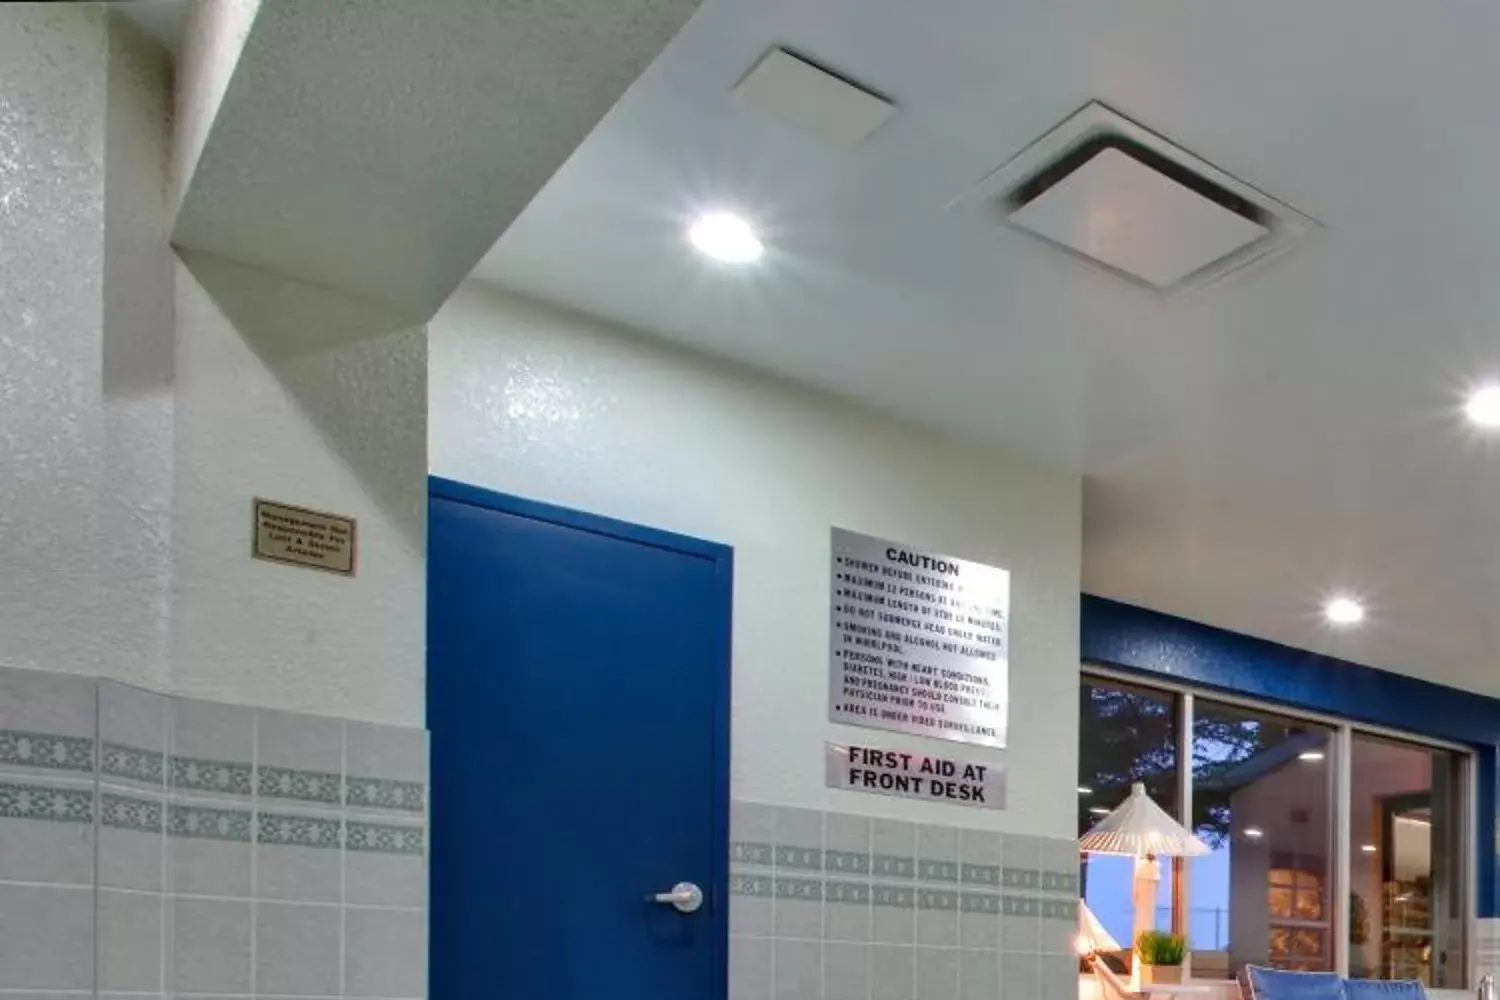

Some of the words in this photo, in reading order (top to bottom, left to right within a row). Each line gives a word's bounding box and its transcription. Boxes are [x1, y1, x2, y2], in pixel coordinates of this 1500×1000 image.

[886, 548, 959, 577] CAUTION
[843, 574, 884, 590] MAXIMUM
[899, 586, 936, 602] PERSONS
[843, 589, 884, 606] MAXIMUM
[887, 599, 918, 613] LENGTH
[843, 605, 856, 616] DO
[858, 609, 875, 619] NOT
[843, 622, 882, 637] SMOKING
[885, 630, 901, 641] AND
[903, 634, 940, 649] ALCOHOL
[943, 642, 957, 652] NOT
[843, 650, 883, 665] PERSONS
[887, 659, 908, 670] WITH
[842, 704, 866, 716] AREA
[849, 746, 912, 770] FIRST
[920, 757, 955, 777] AID
[962, 763, 987, 782] AT
[850, 769, 924, 793] FRONT
[930, 780, 986, 803] DESK
